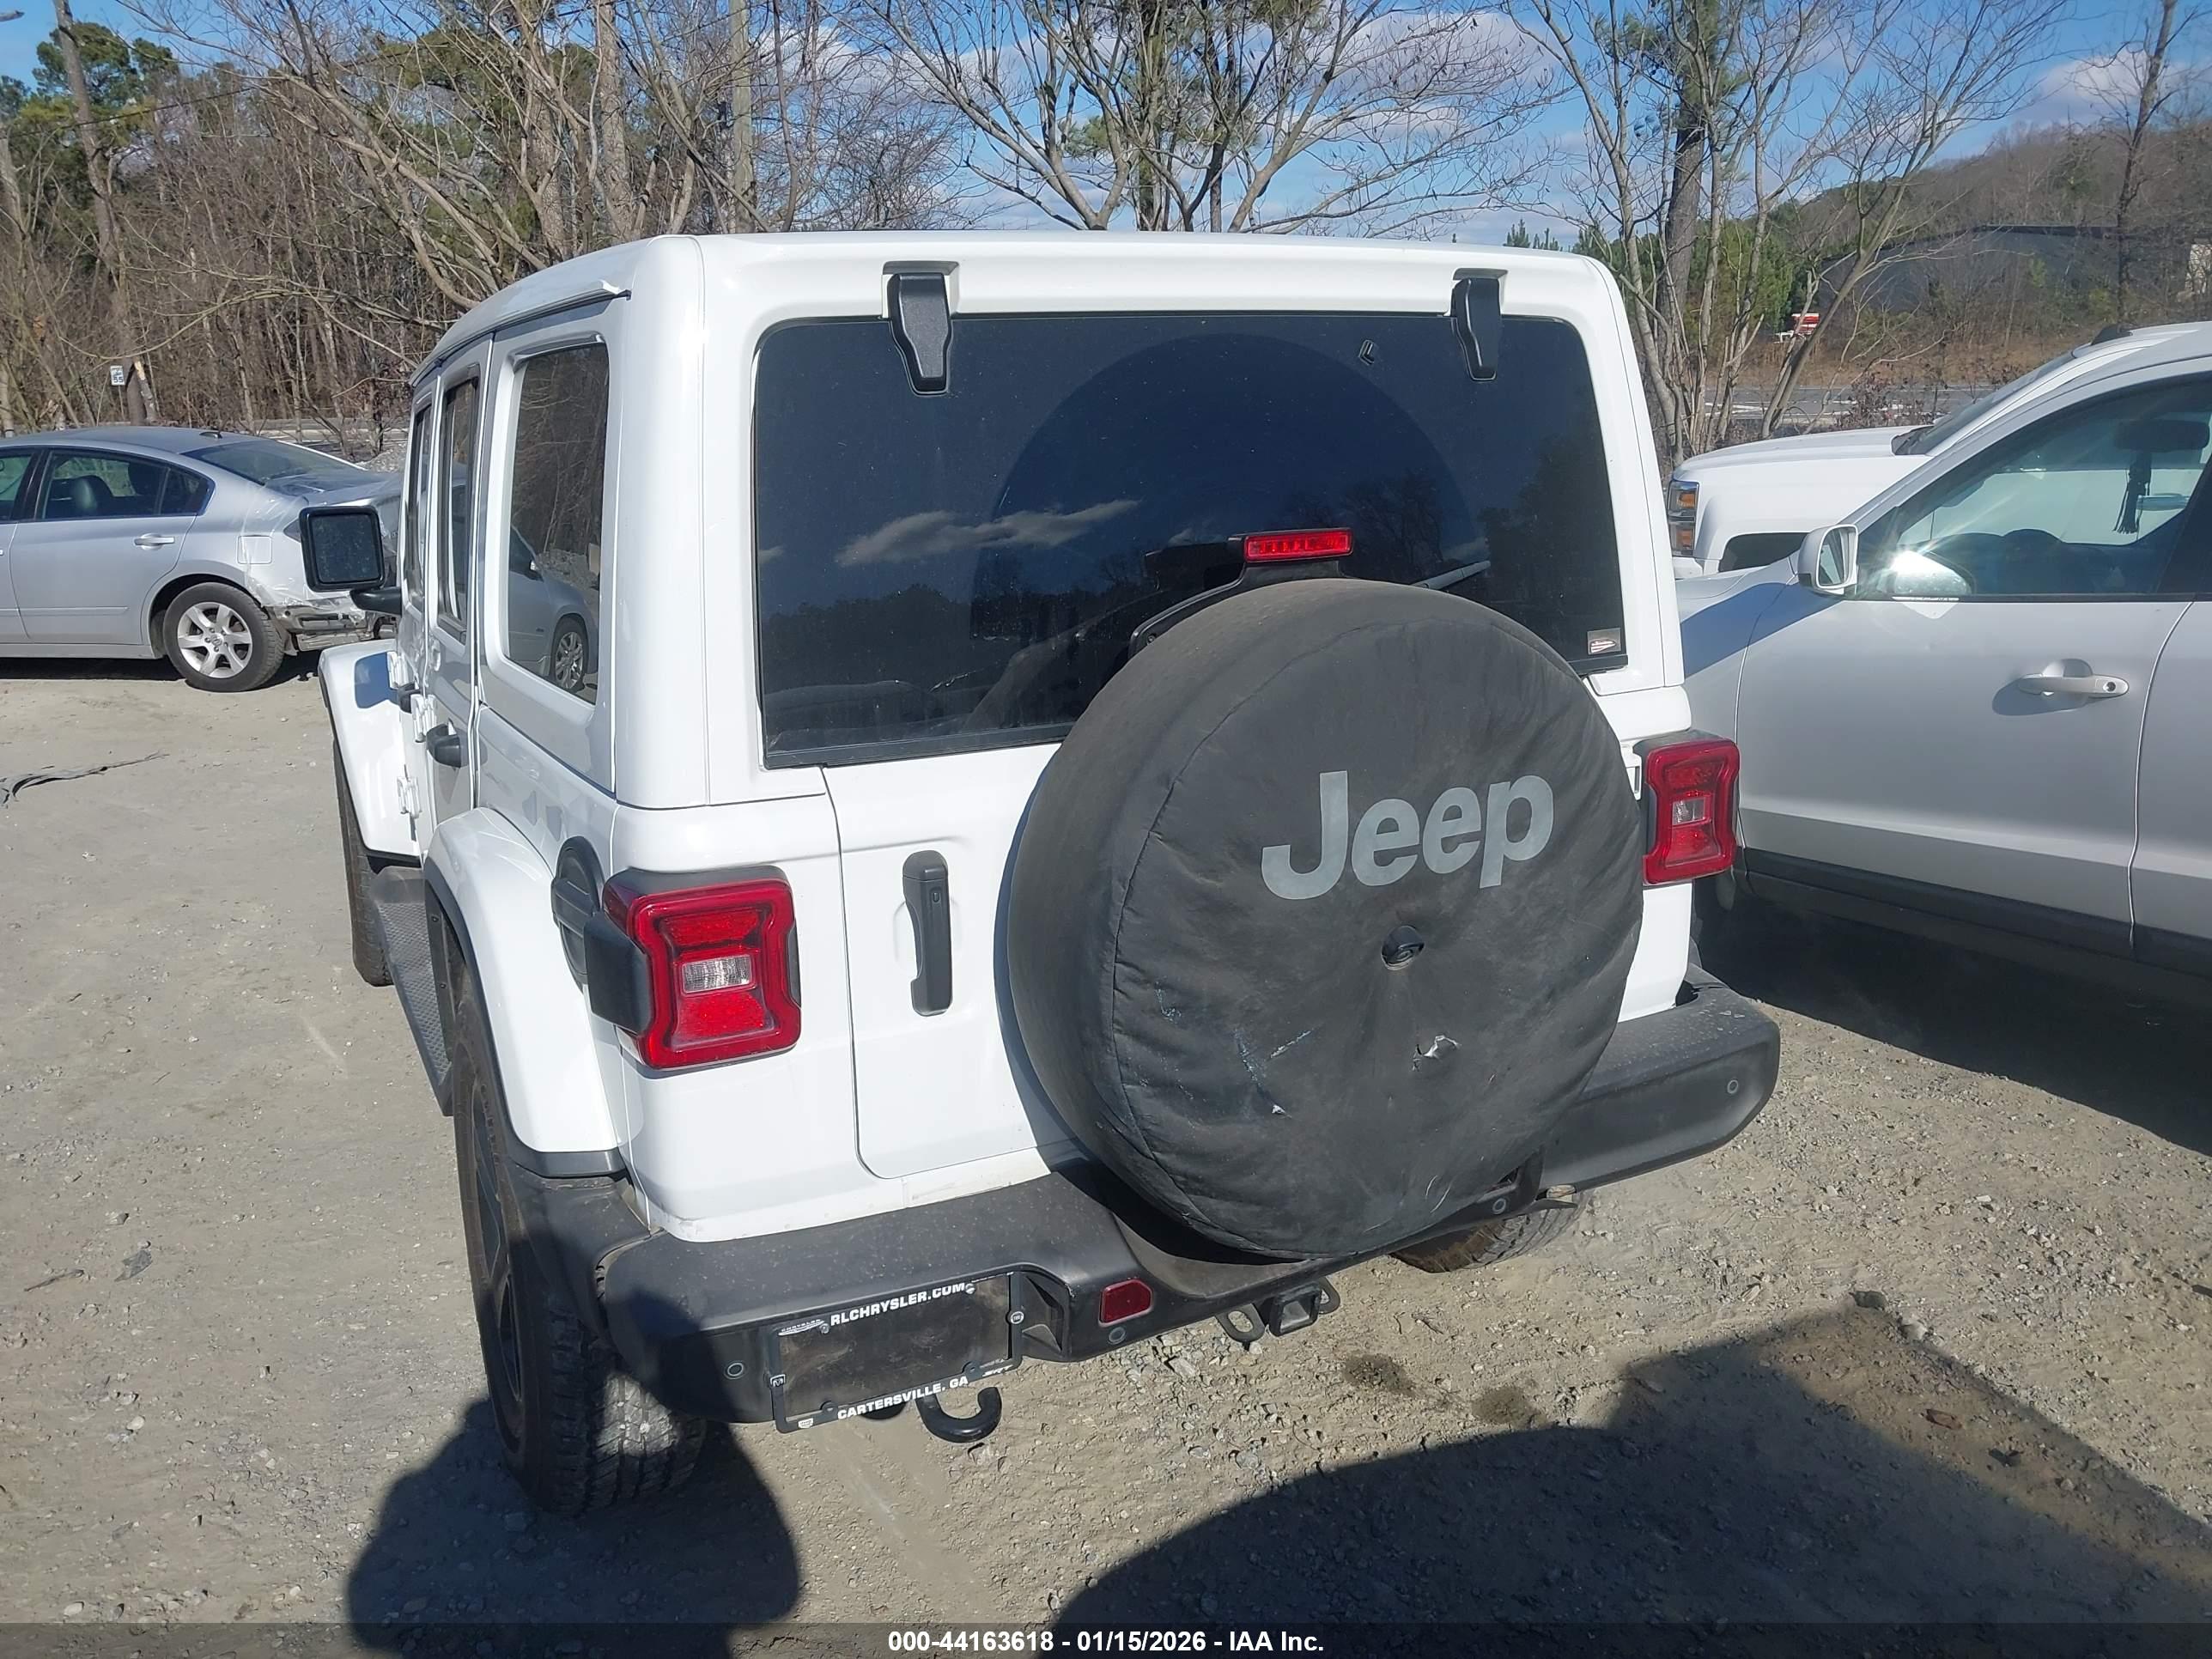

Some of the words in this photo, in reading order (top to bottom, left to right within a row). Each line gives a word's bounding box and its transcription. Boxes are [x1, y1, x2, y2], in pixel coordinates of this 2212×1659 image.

[1261, 770, 1553, 900] Jeep
[830, 1282, 965, 1327] RLCHRYSLER.COM
[949, 1376, 969, 1389] GA
